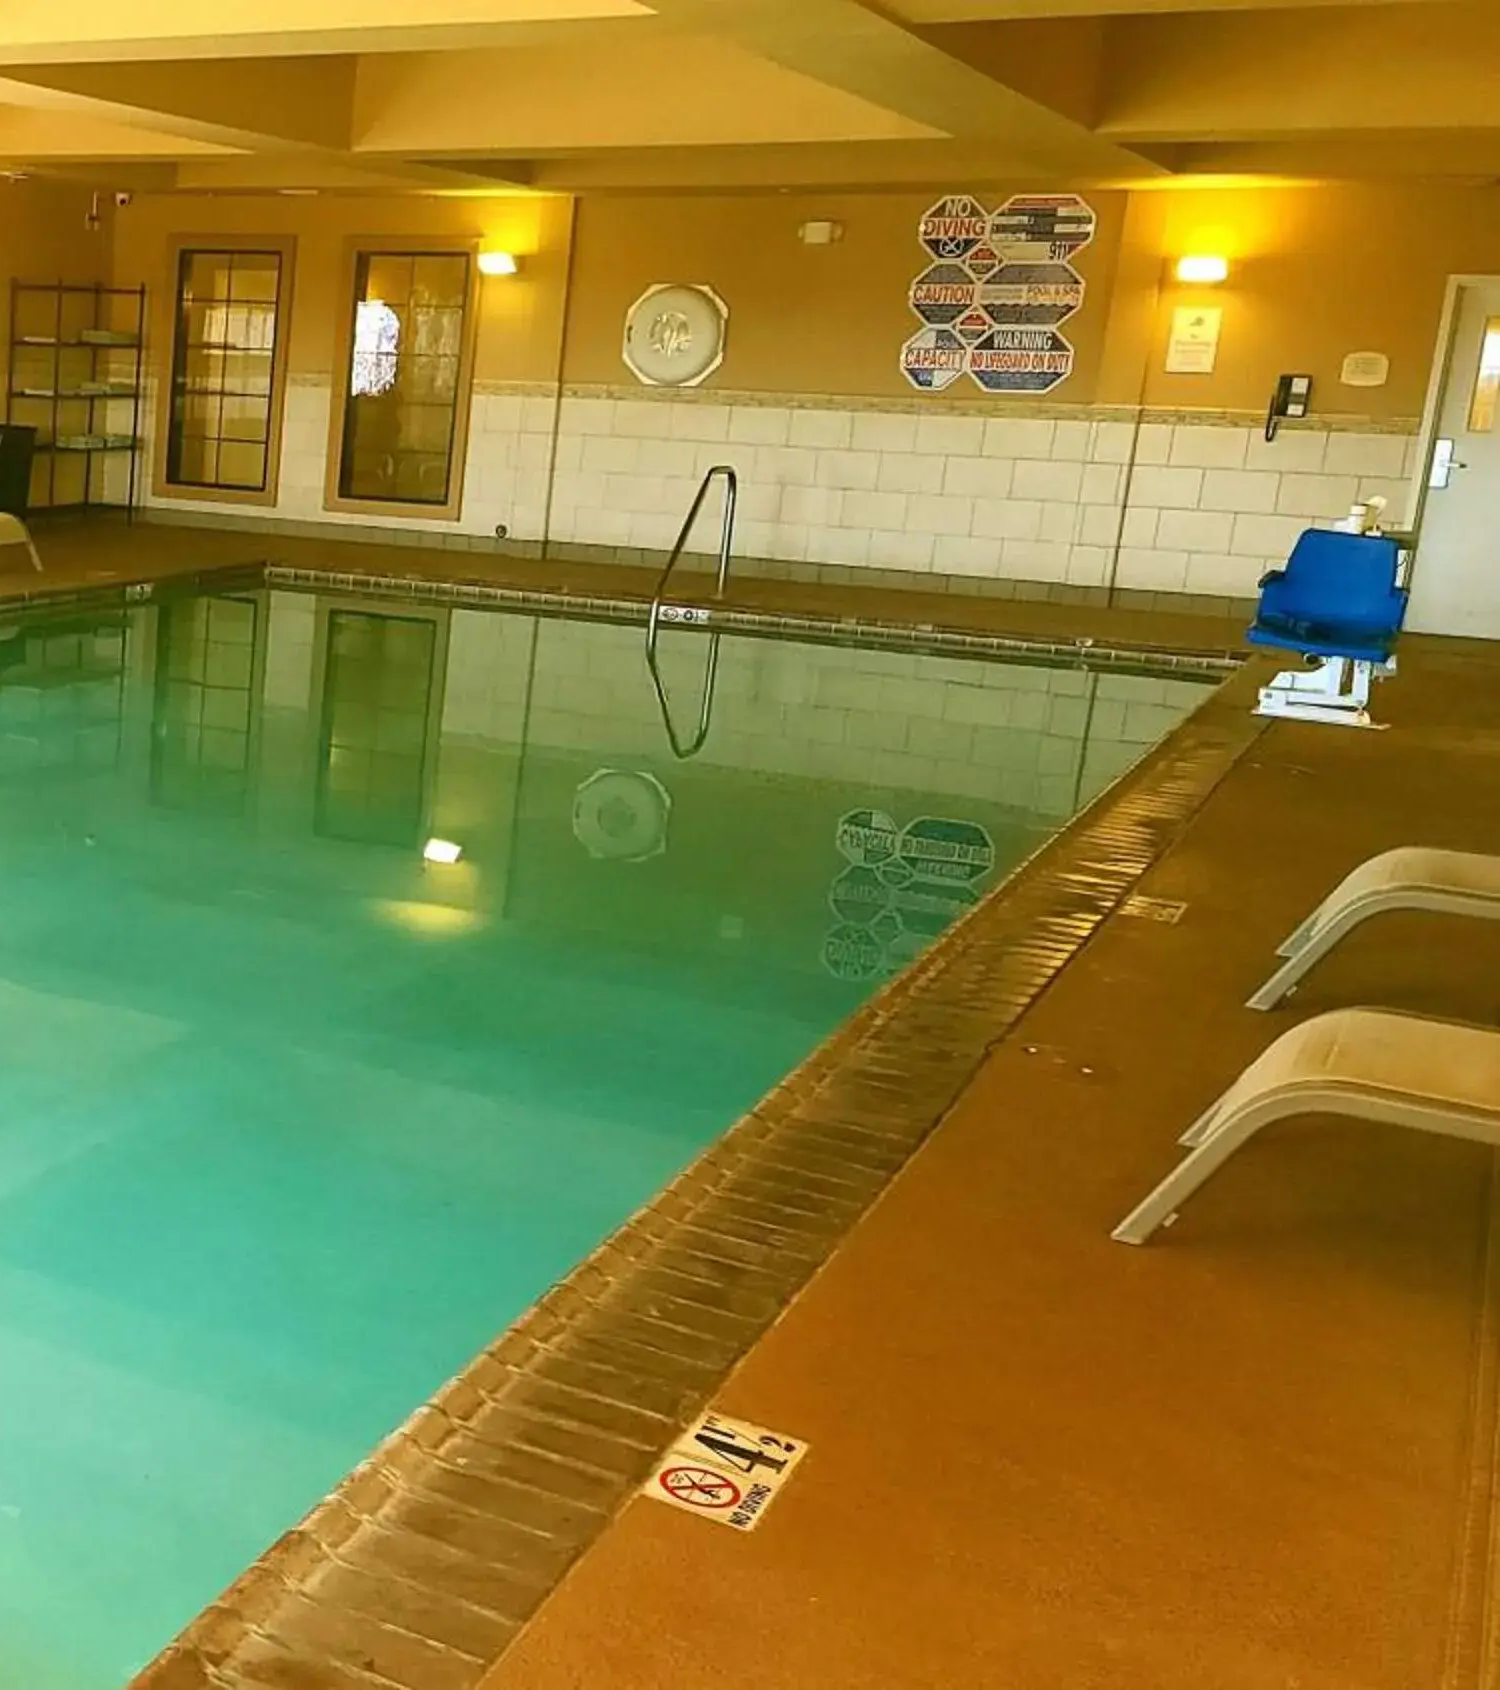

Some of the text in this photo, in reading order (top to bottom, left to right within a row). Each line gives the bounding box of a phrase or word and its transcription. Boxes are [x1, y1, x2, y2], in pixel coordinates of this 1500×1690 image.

[944, 199, 970, 216] NO
[923, 219, 985, 238] DIVING
[914, 285, 974, 304] CAUTION
[993, 331, 1053, 350] WARNING
[906, 348, 963, 368] CAPACITY
[971, 351, 984, 369] NO
[1032, 353, 1046, 370] ON
[738, 1483, 772, 1514] DIVING
